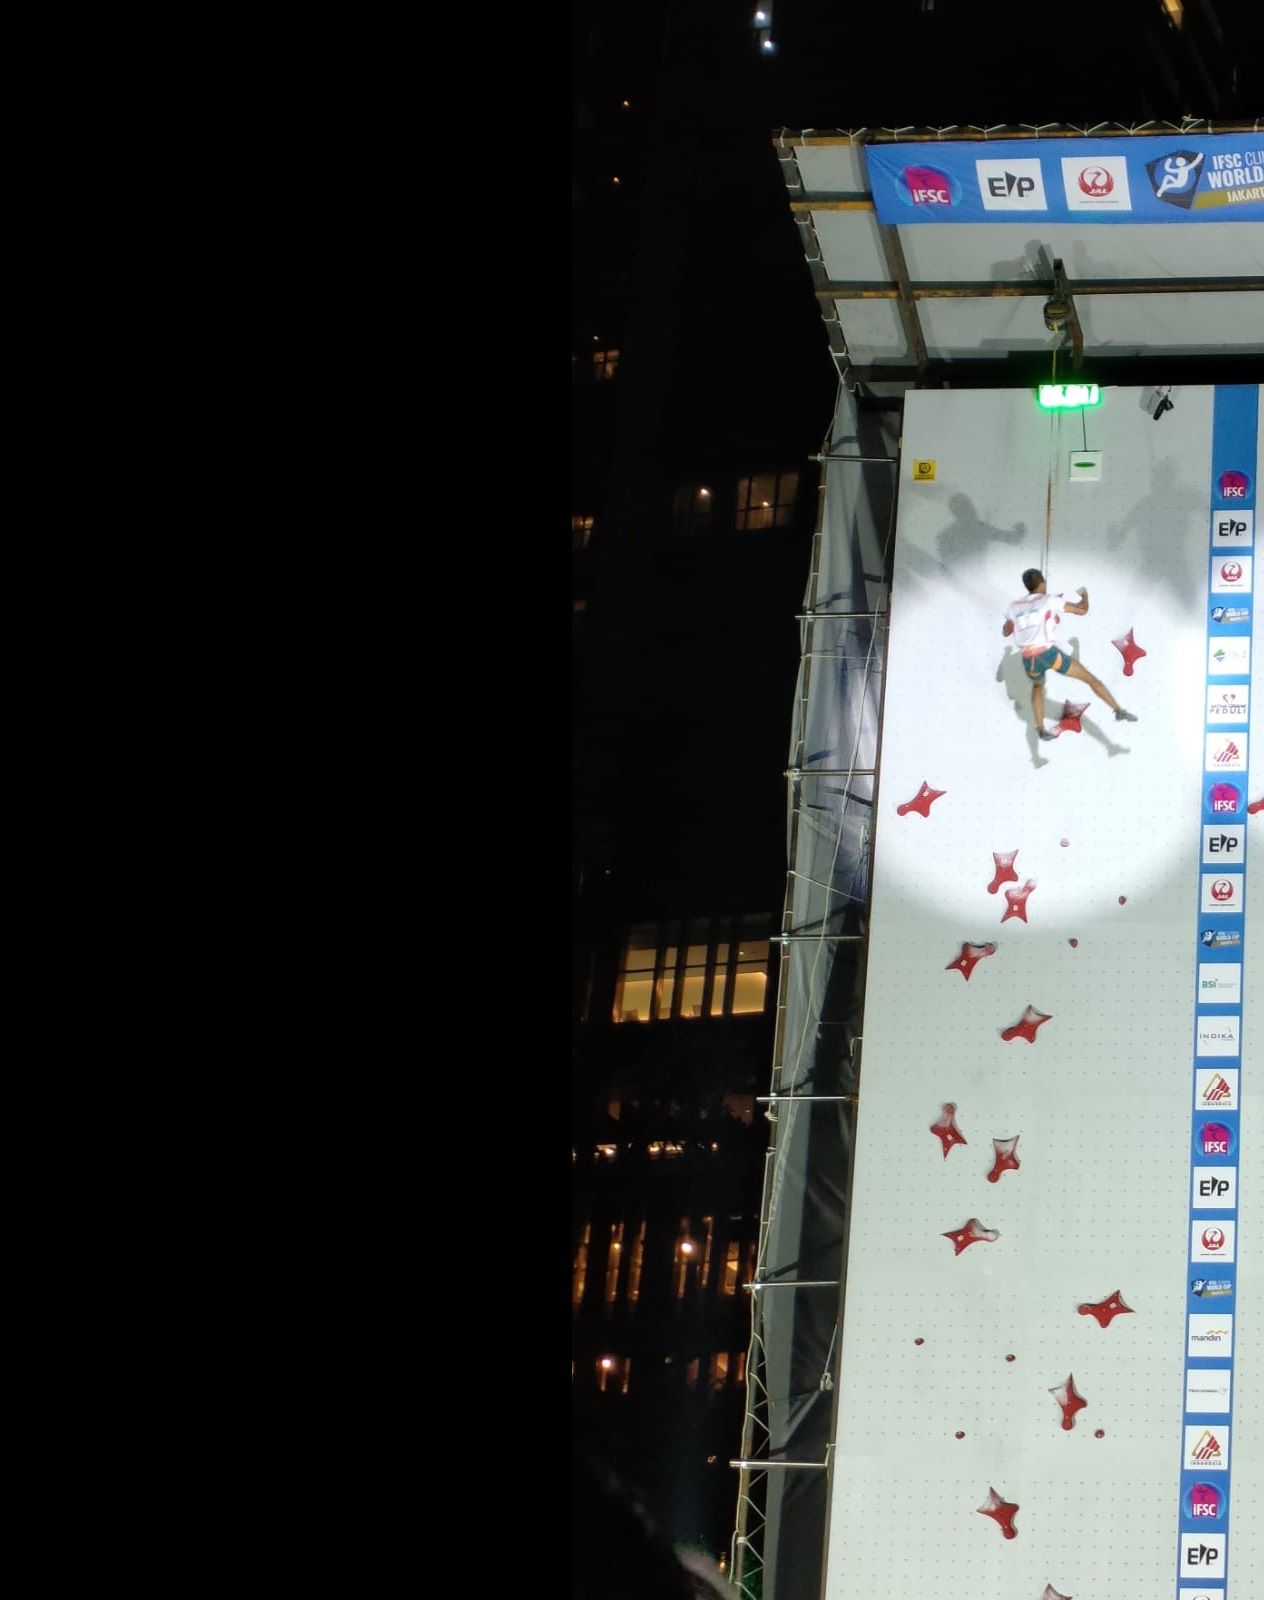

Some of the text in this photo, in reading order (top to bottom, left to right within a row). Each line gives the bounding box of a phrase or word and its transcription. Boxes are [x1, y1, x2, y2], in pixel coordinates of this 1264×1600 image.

[1212, 153, 1241, 170] IFSC
[1207, 165, 1264, 189] WORLD
[912, 189, 949, 203] IFSC
[1223, 486, 1245, 497] IFSC
[1214, 799, 1236, 811] IFSC
[1202, 980, 1216, 989] BSI
[1204, 1141, 1227, 1153] IFSC
[1193, 1504, 1216, 1516] IFSC
